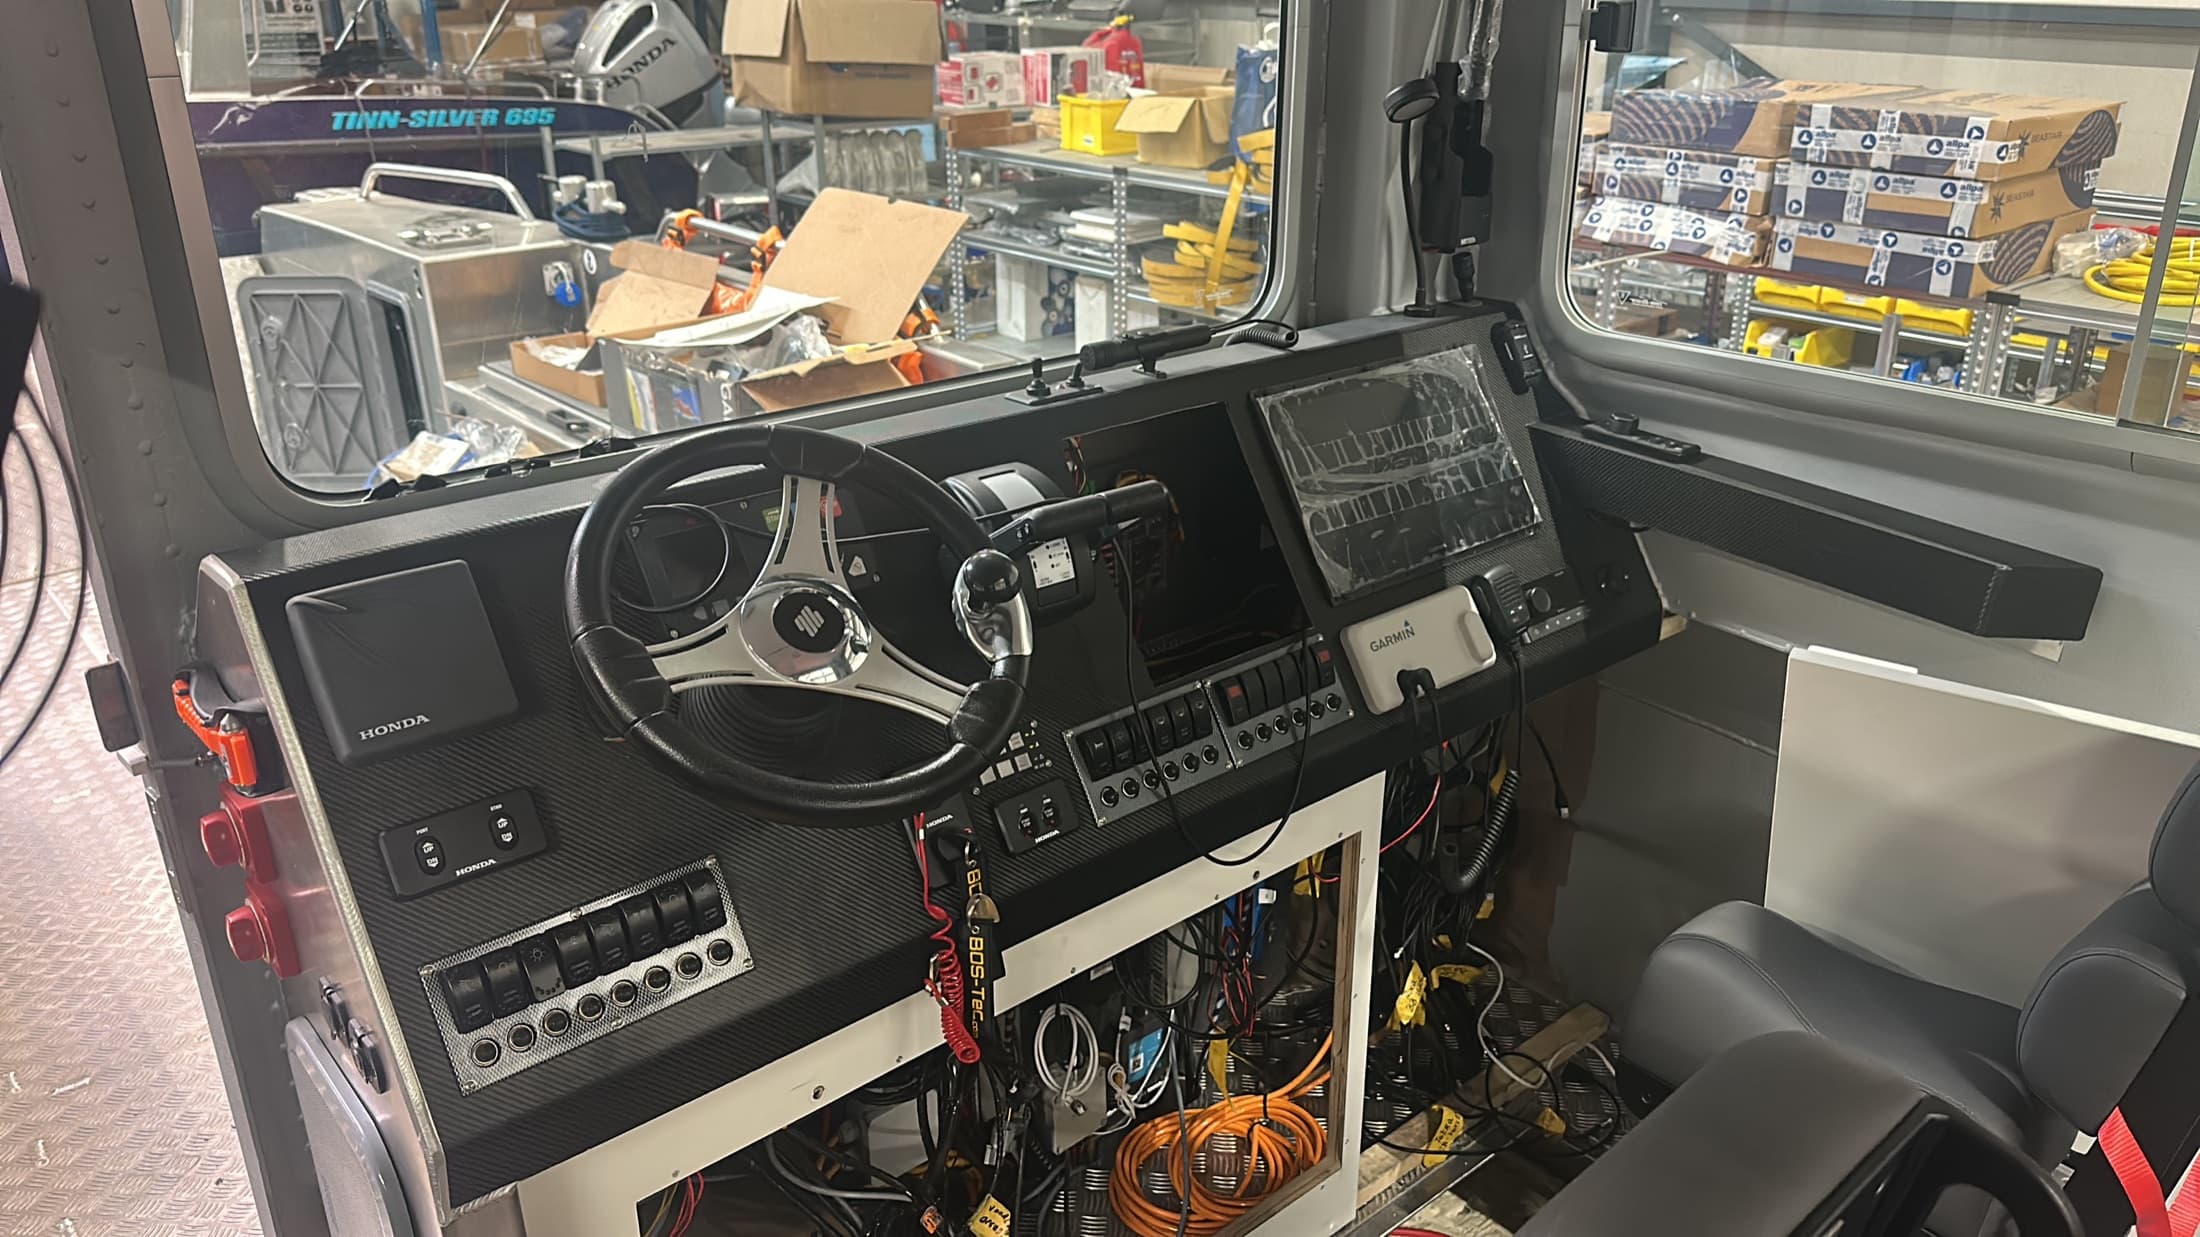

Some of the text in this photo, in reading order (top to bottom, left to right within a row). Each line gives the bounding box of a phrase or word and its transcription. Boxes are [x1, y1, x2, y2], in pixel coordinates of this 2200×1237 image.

[606, 38, 676, 88] HONDA
[331, 107, 556, 130] TINN-SILVER 695
[1946, 140, 1970, 149] allpa
[1959, 183, 1984, 193] allpa
[720, 383, 734, 421] GA
[1370, 626, 1415, 652] GARMIN
[359, 714, 430, 740] HONDA
[926, 814, 953, 829] HONDA
[456, 858, 497, 877] HONDA
